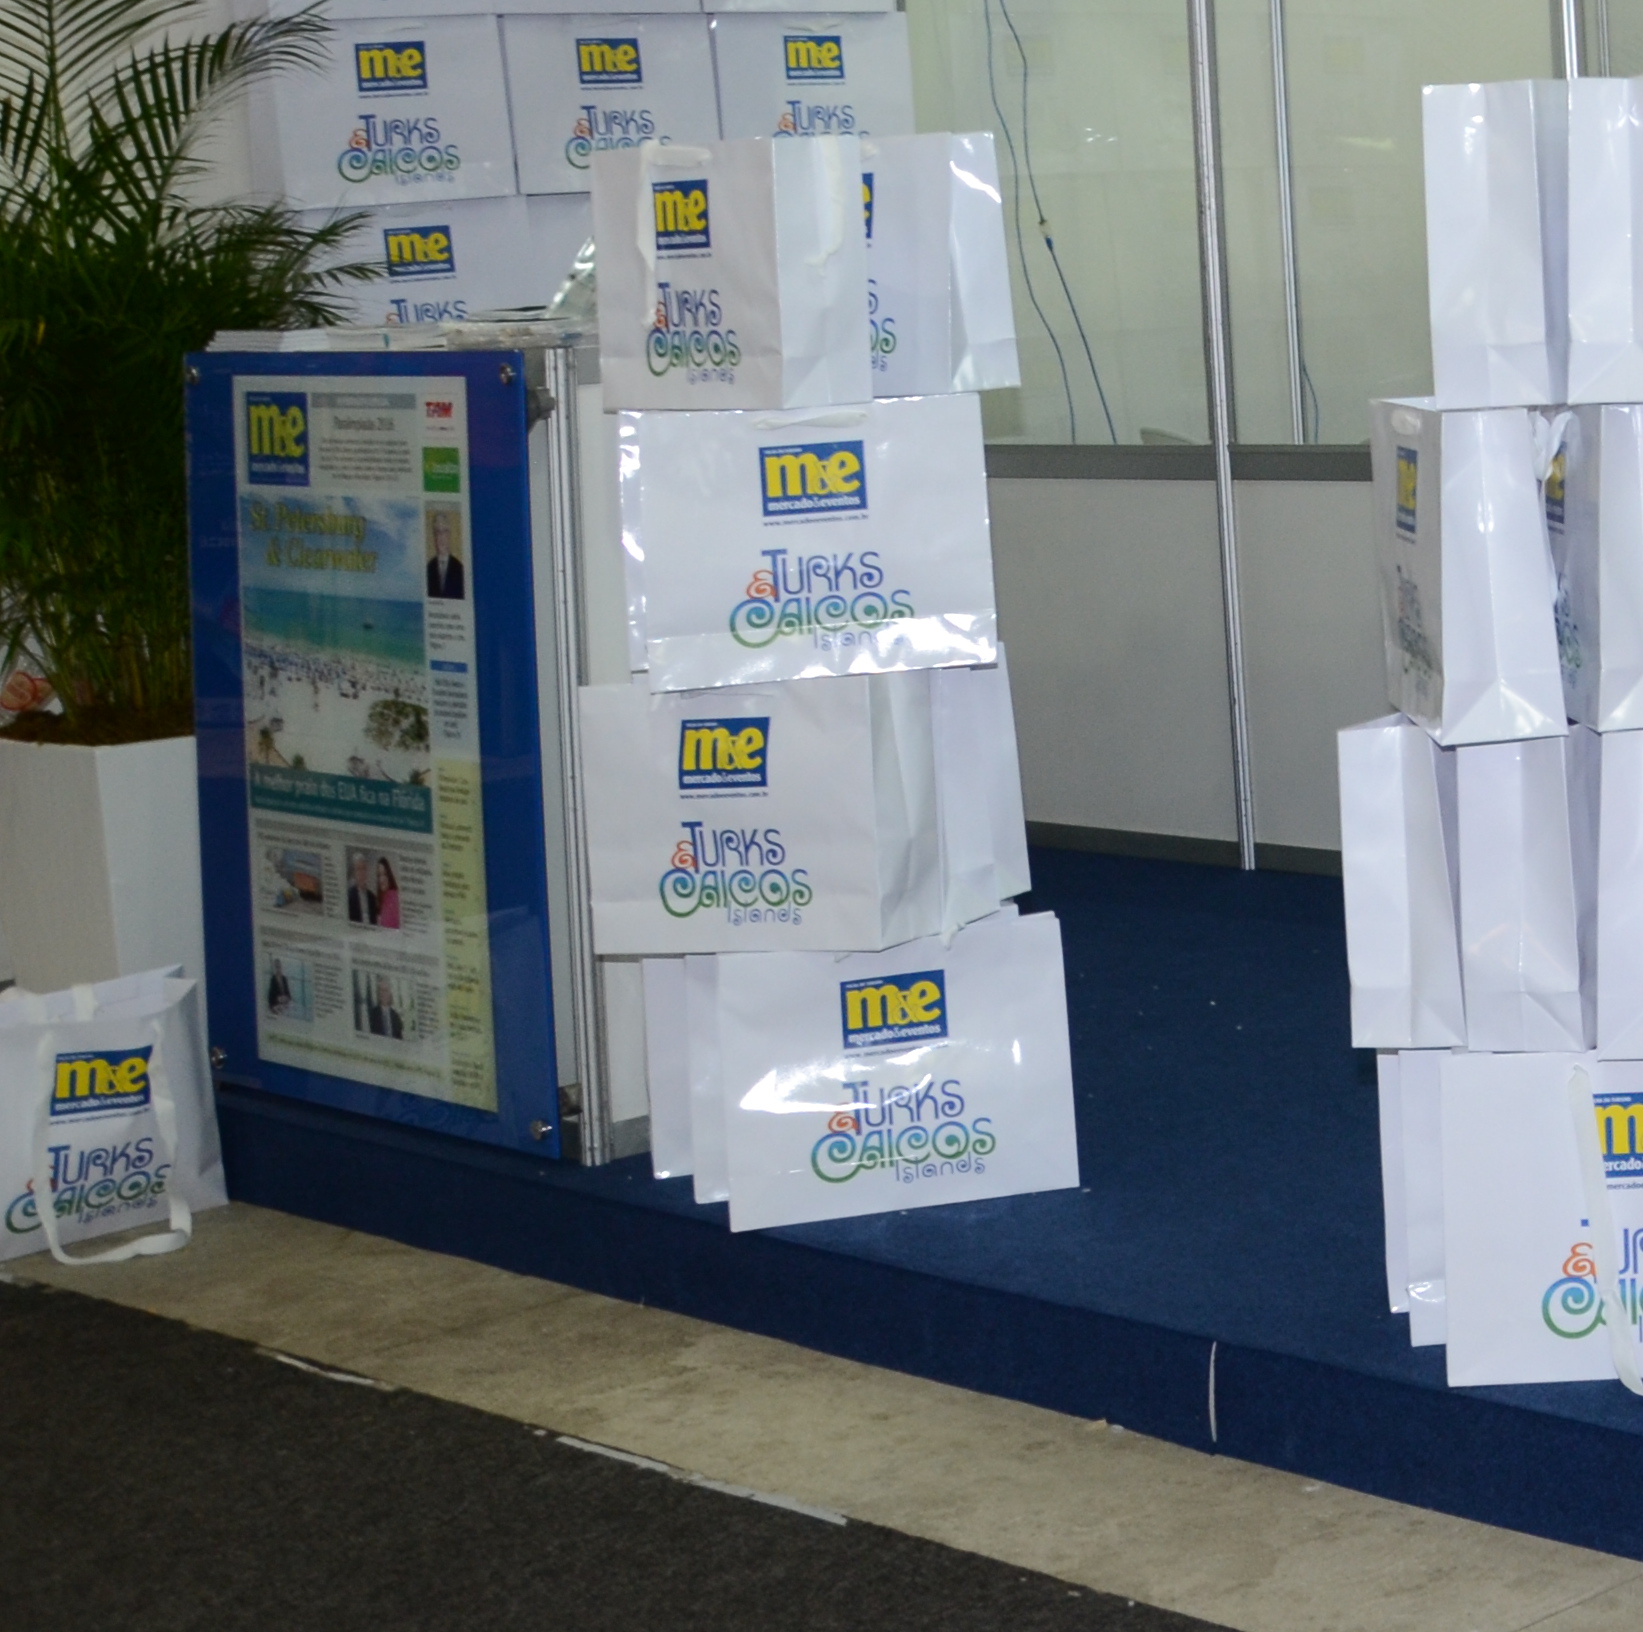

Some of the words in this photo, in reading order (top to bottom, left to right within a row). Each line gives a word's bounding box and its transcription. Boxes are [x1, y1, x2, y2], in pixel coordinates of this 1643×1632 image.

[764, 451, 861, 498] m&e
[761, 549, 884, 603] TURKS
[682, 726, 764, 771] m&e
[681, 821, 785, 874] TURKS
[846, 980, 941, 1030] m&e
[842, 1079, 965, 1135] TURKS
[48, 1137, 154, 1193] TURKS
